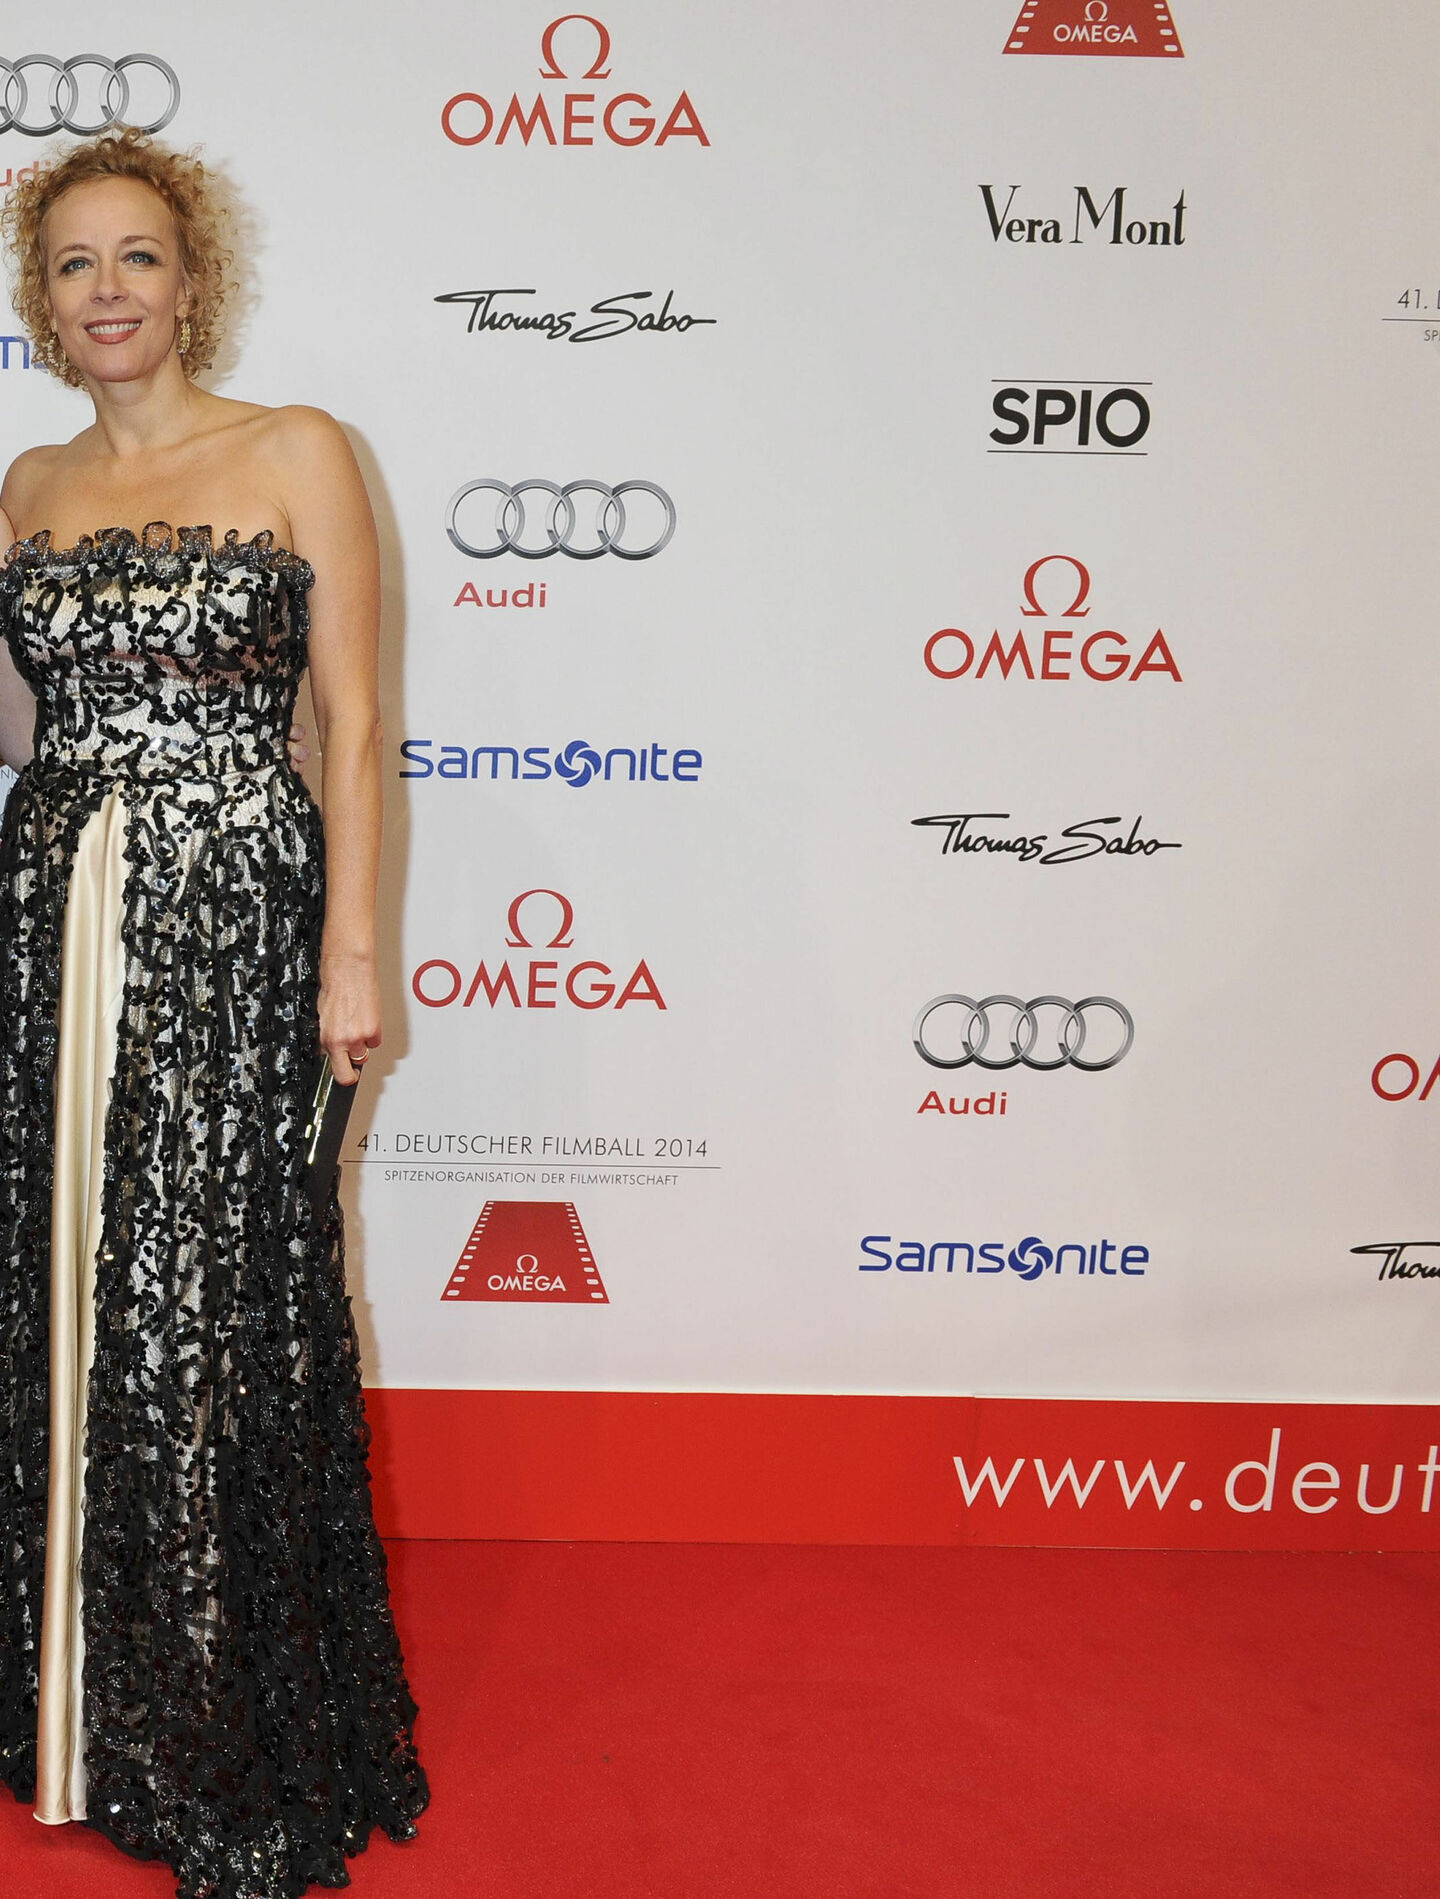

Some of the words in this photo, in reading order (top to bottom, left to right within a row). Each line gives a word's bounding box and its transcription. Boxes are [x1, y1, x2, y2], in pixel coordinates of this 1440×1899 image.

[1054, 23, 1138, 43] OMEGA
[441, 90, 711, 147] OMEGA
[977, 184, 1062, 244] Vera
[1069, 186, 1188, 246] Mont
[434, 289, 576, 340] Thomas
[568, 289, 718, 343] Sabo
[1397, 288, 1428, 309] 41.
[989, 388, 1151, 448] SPIO
[454, 583, 547, 609] Audi
[923, 628, 1184, 683] OMEGA
[399, 739, 703, 787] Samsonite
[911, 813, 1048, 861] Thomas
[1039, 815, 1183, 865] Sabo
[412, 958, 668, 1011] OMEGA
[916, 1091, 1007, 1116] Audi
[357, 1134, 387, 1153] 41.
[396, 1134, 532, 1155] DEUTSCHER
[542, 1137, 645, 1157] FILMBALL
[654, 1138, 707, 1158] 2014
[384, 1170, 536, 1184] SPITZENORGANISATION
[541, 1172, 565, 1184] DER
[570, 1173, 679, 1186] FILMWIRTSCHAFT
[859, 1235, 1150, 1281] Samsonite
[487, 1274, 567, 1292] OMEGA
